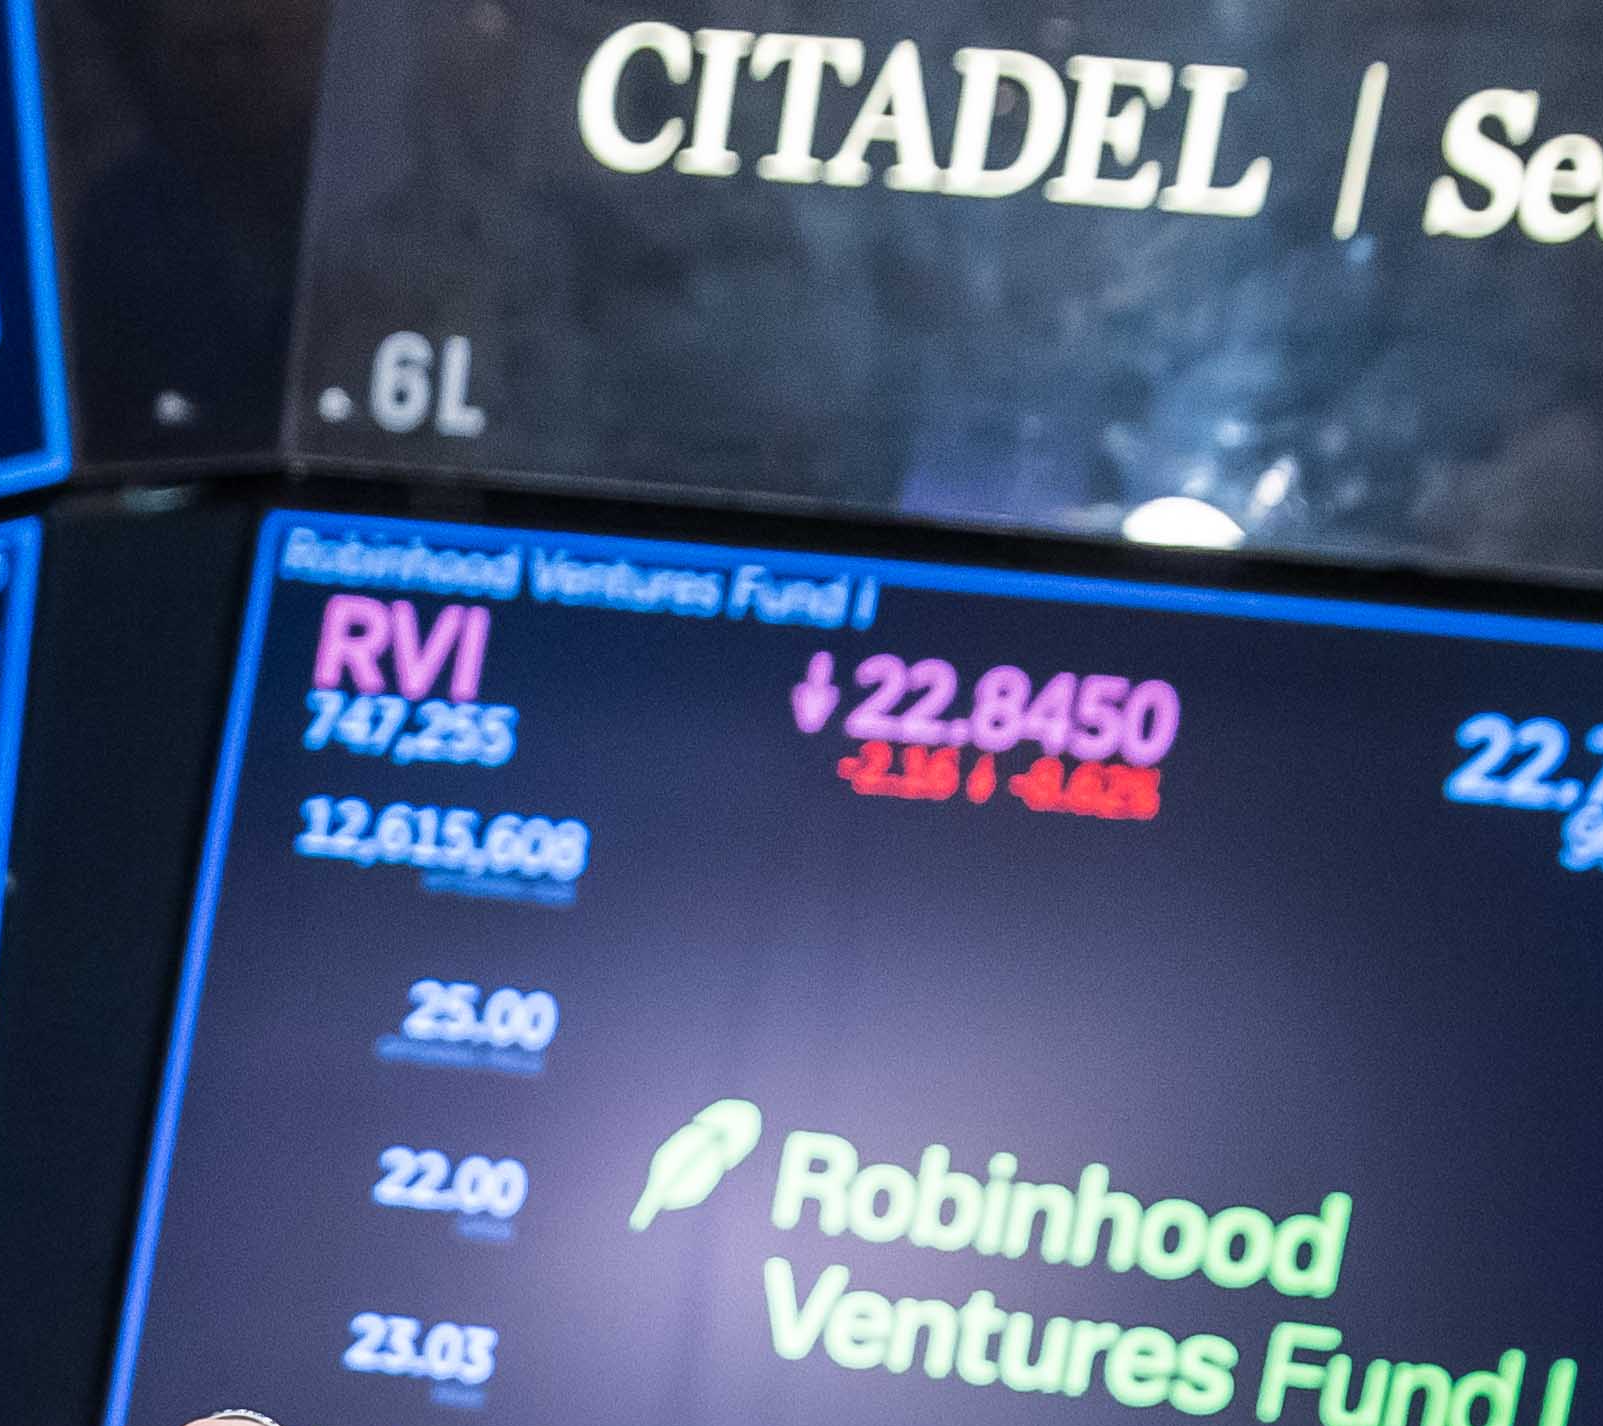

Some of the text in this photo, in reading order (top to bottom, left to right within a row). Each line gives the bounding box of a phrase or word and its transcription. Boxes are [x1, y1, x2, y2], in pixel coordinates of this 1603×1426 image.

[578, 21, 1273, 218] CITADEL
[280, 526, 522, 602] Robinhood
[528, 543, 726, 619] Ventures
[726, 562, 850, 630] Fund
[312, 592, 492, 703] RVI
[843, 653, 1181, 767] 22.8450
[402, 976, 561, 1052] 25.00
[371, 1145, 530, 1219] 22.00
[769, 1129, 1352, 1301] Robinhood
[342, 1311, 500, 1386] 23.03
[763, 1252, 1240, 1417] Ventures
